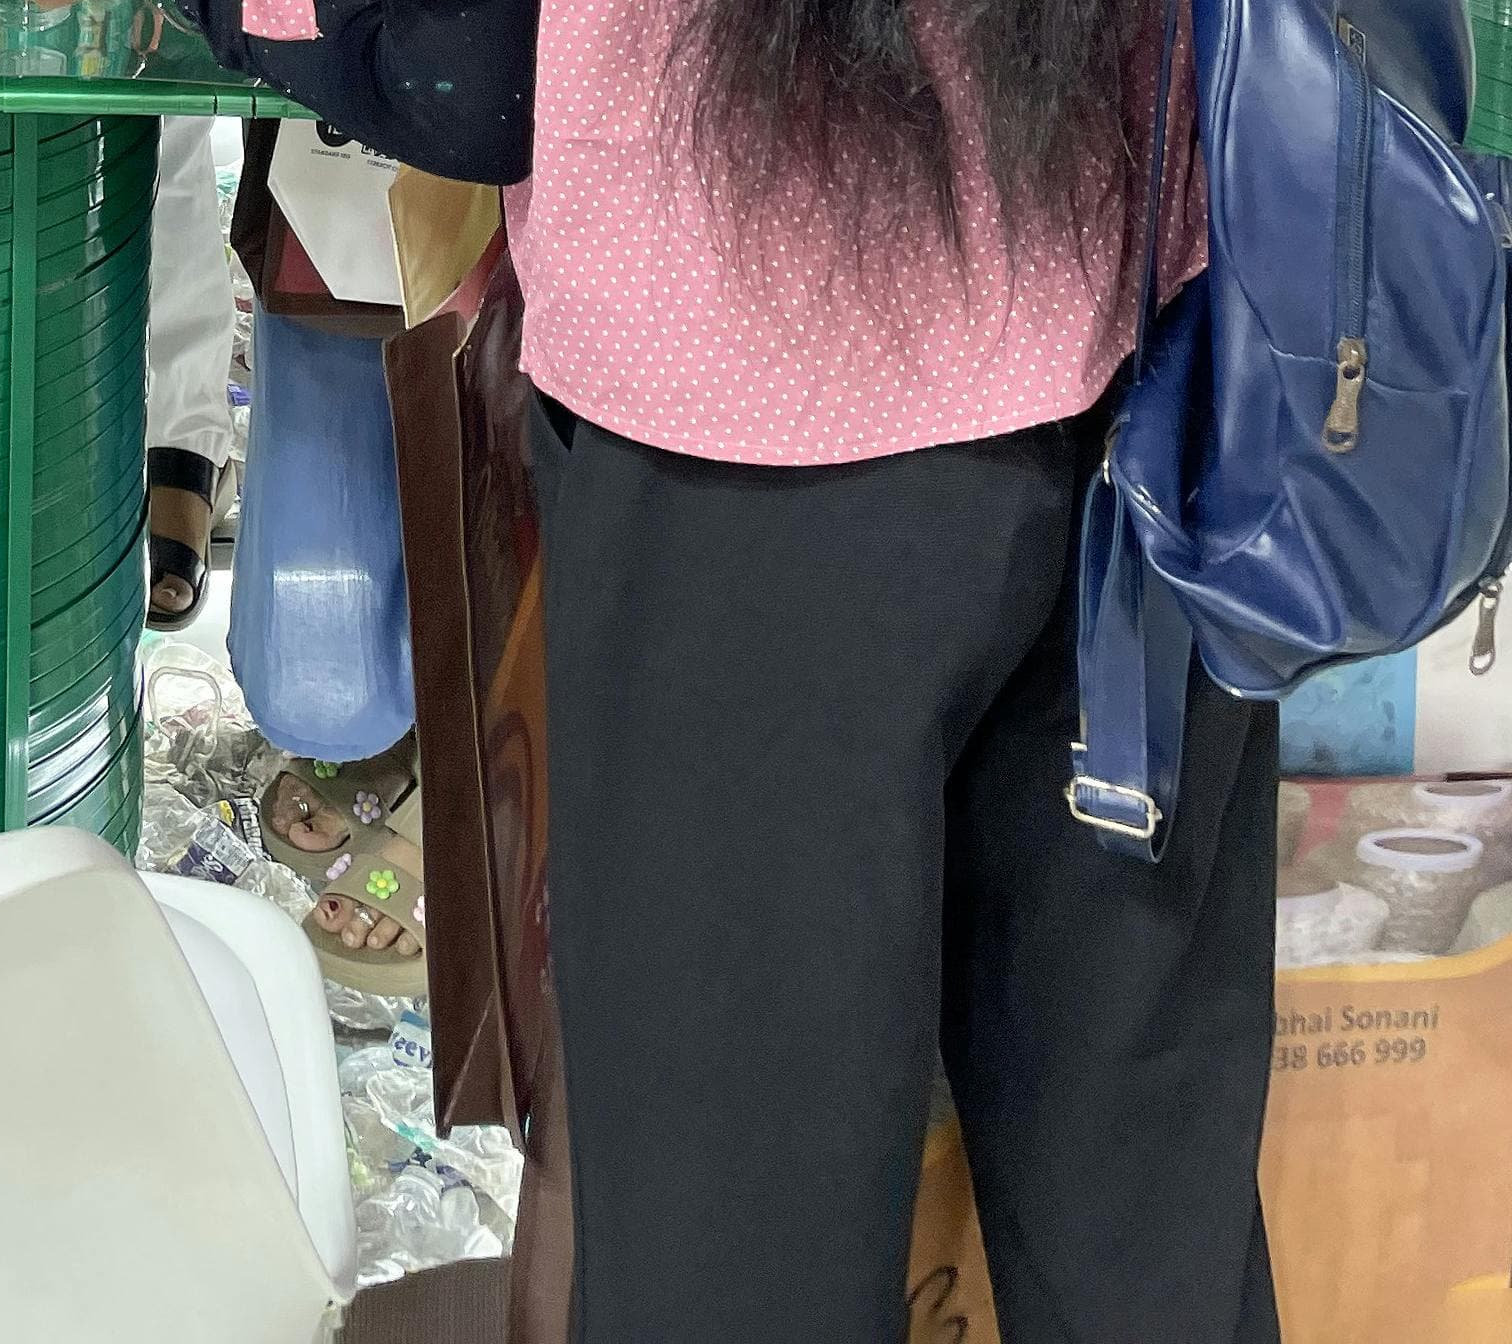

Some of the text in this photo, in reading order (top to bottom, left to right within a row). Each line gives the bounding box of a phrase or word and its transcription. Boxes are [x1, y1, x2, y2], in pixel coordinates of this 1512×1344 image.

[1341, 1002, 1441, 1032] Sonani
[1317, 1038, 1367, 1069] 666
[1374, 1035, 1427, 1065] 999
